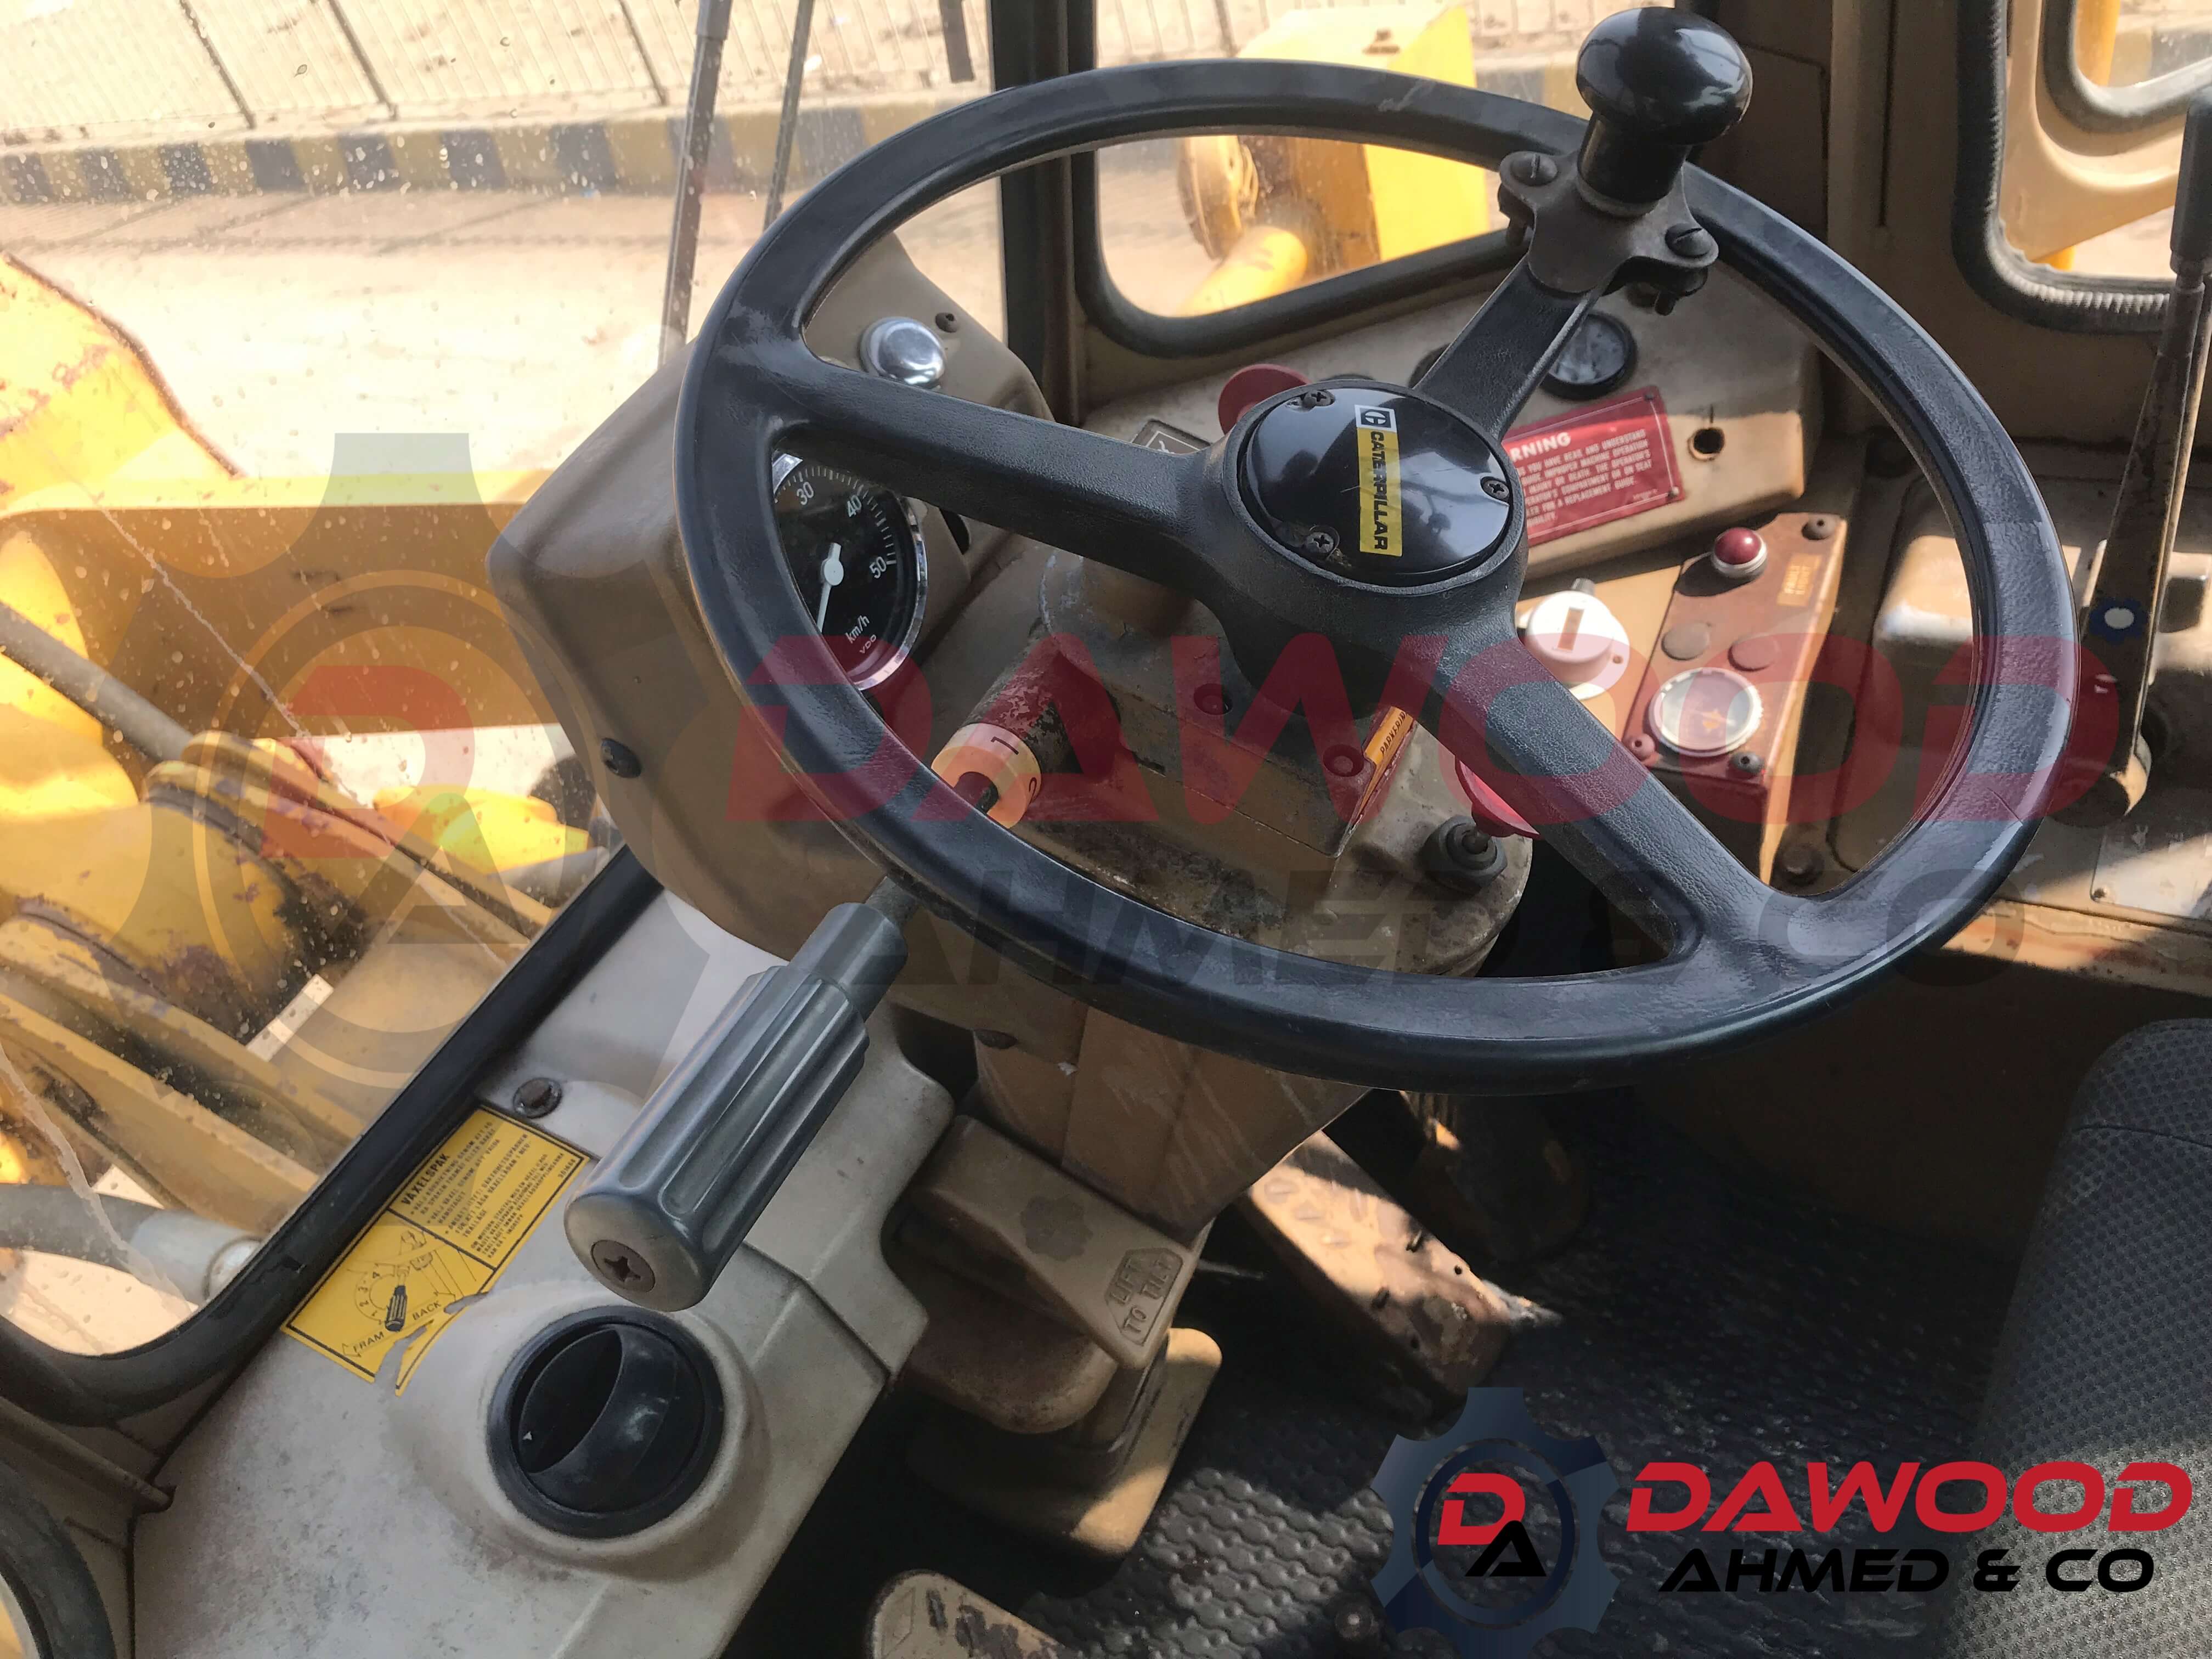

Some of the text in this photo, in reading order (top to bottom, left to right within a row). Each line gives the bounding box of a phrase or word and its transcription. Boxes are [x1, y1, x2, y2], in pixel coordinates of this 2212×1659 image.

[1510, 431, 1571, 462] RNING
[797, 481, 814, 505] 30
[1370, 431, 1388, 550] CATERPILLAR
[847, 495, 862, 517] 40
[870, 556, 887, 579] 50
[845, 615, 870, 644] km/h
[859, 634, 877, 653] VDO
[1380, 712, 1407, 755] PARKERIN
[991, 736, 1019, 755] 1
[412, 1301, 441, 1321] BACK
